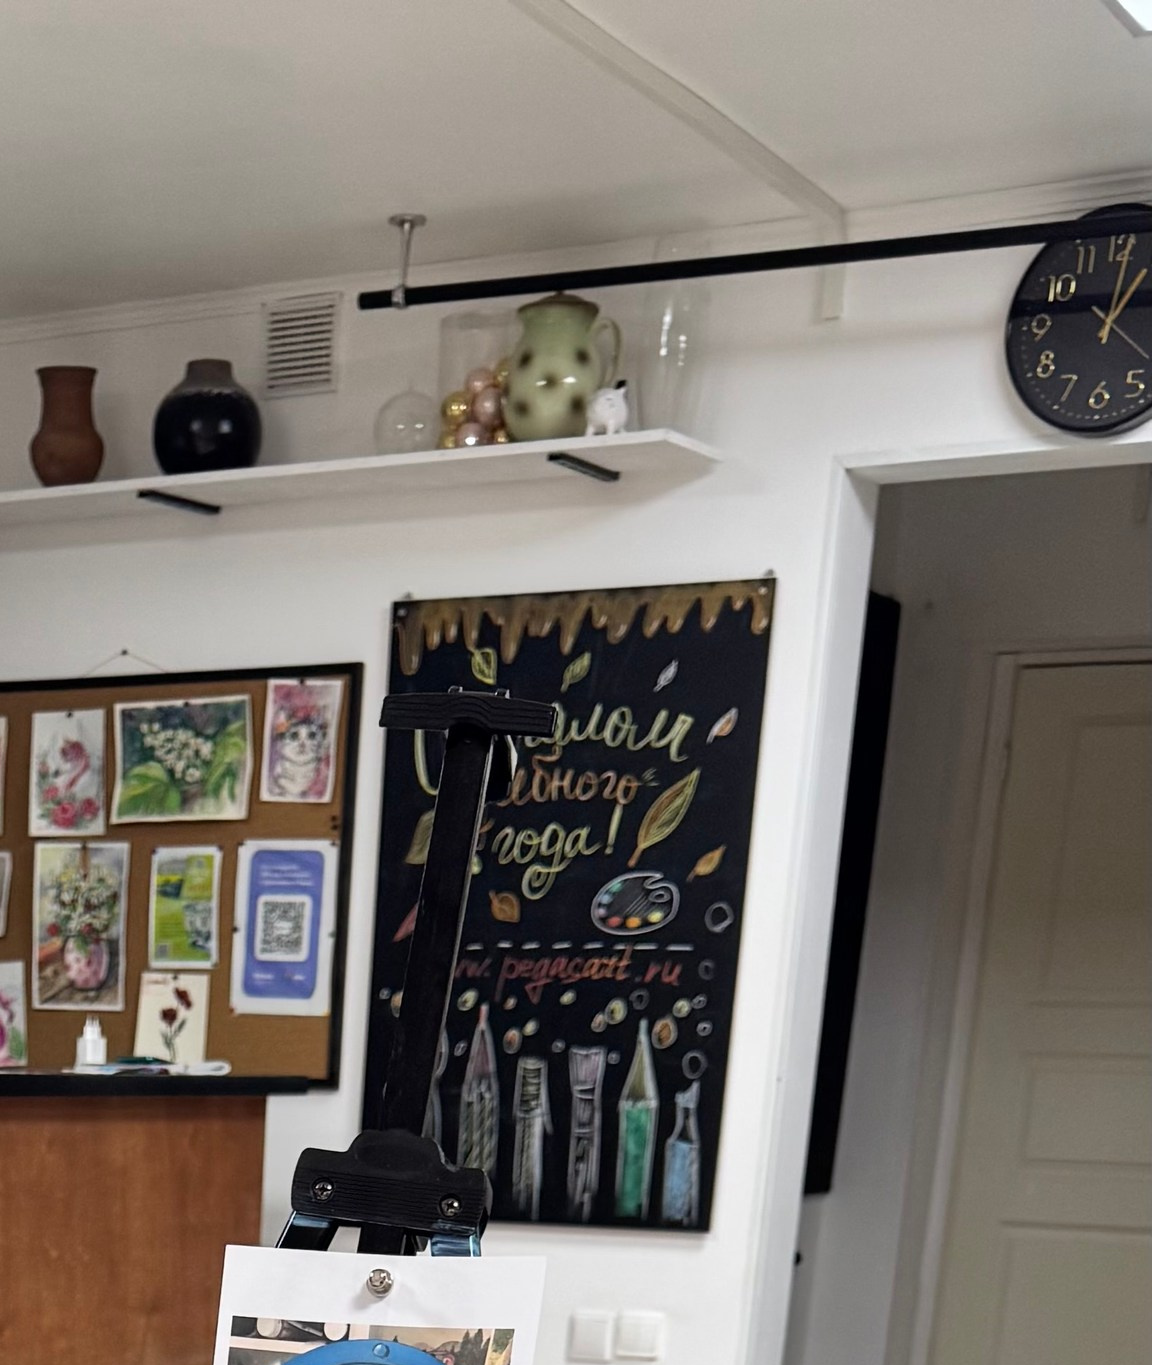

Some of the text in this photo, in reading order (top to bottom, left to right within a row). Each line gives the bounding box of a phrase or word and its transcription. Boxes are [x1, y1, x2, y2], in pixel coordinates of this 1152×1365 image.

[1077, 245, 1096, 274] 11
[1048, 274, 1076, 302] 10
[1031, 313, 1052, 342] 9
[1036, 350, 1055, 378] 8
[1060, 374, 1078, 402] 7
[1088, 381, 1111, 409] 6
[1124, 369, 1146, 398] 5
[496, 745, 640, 808] ебного
[491, 801, 624, 900] года!
